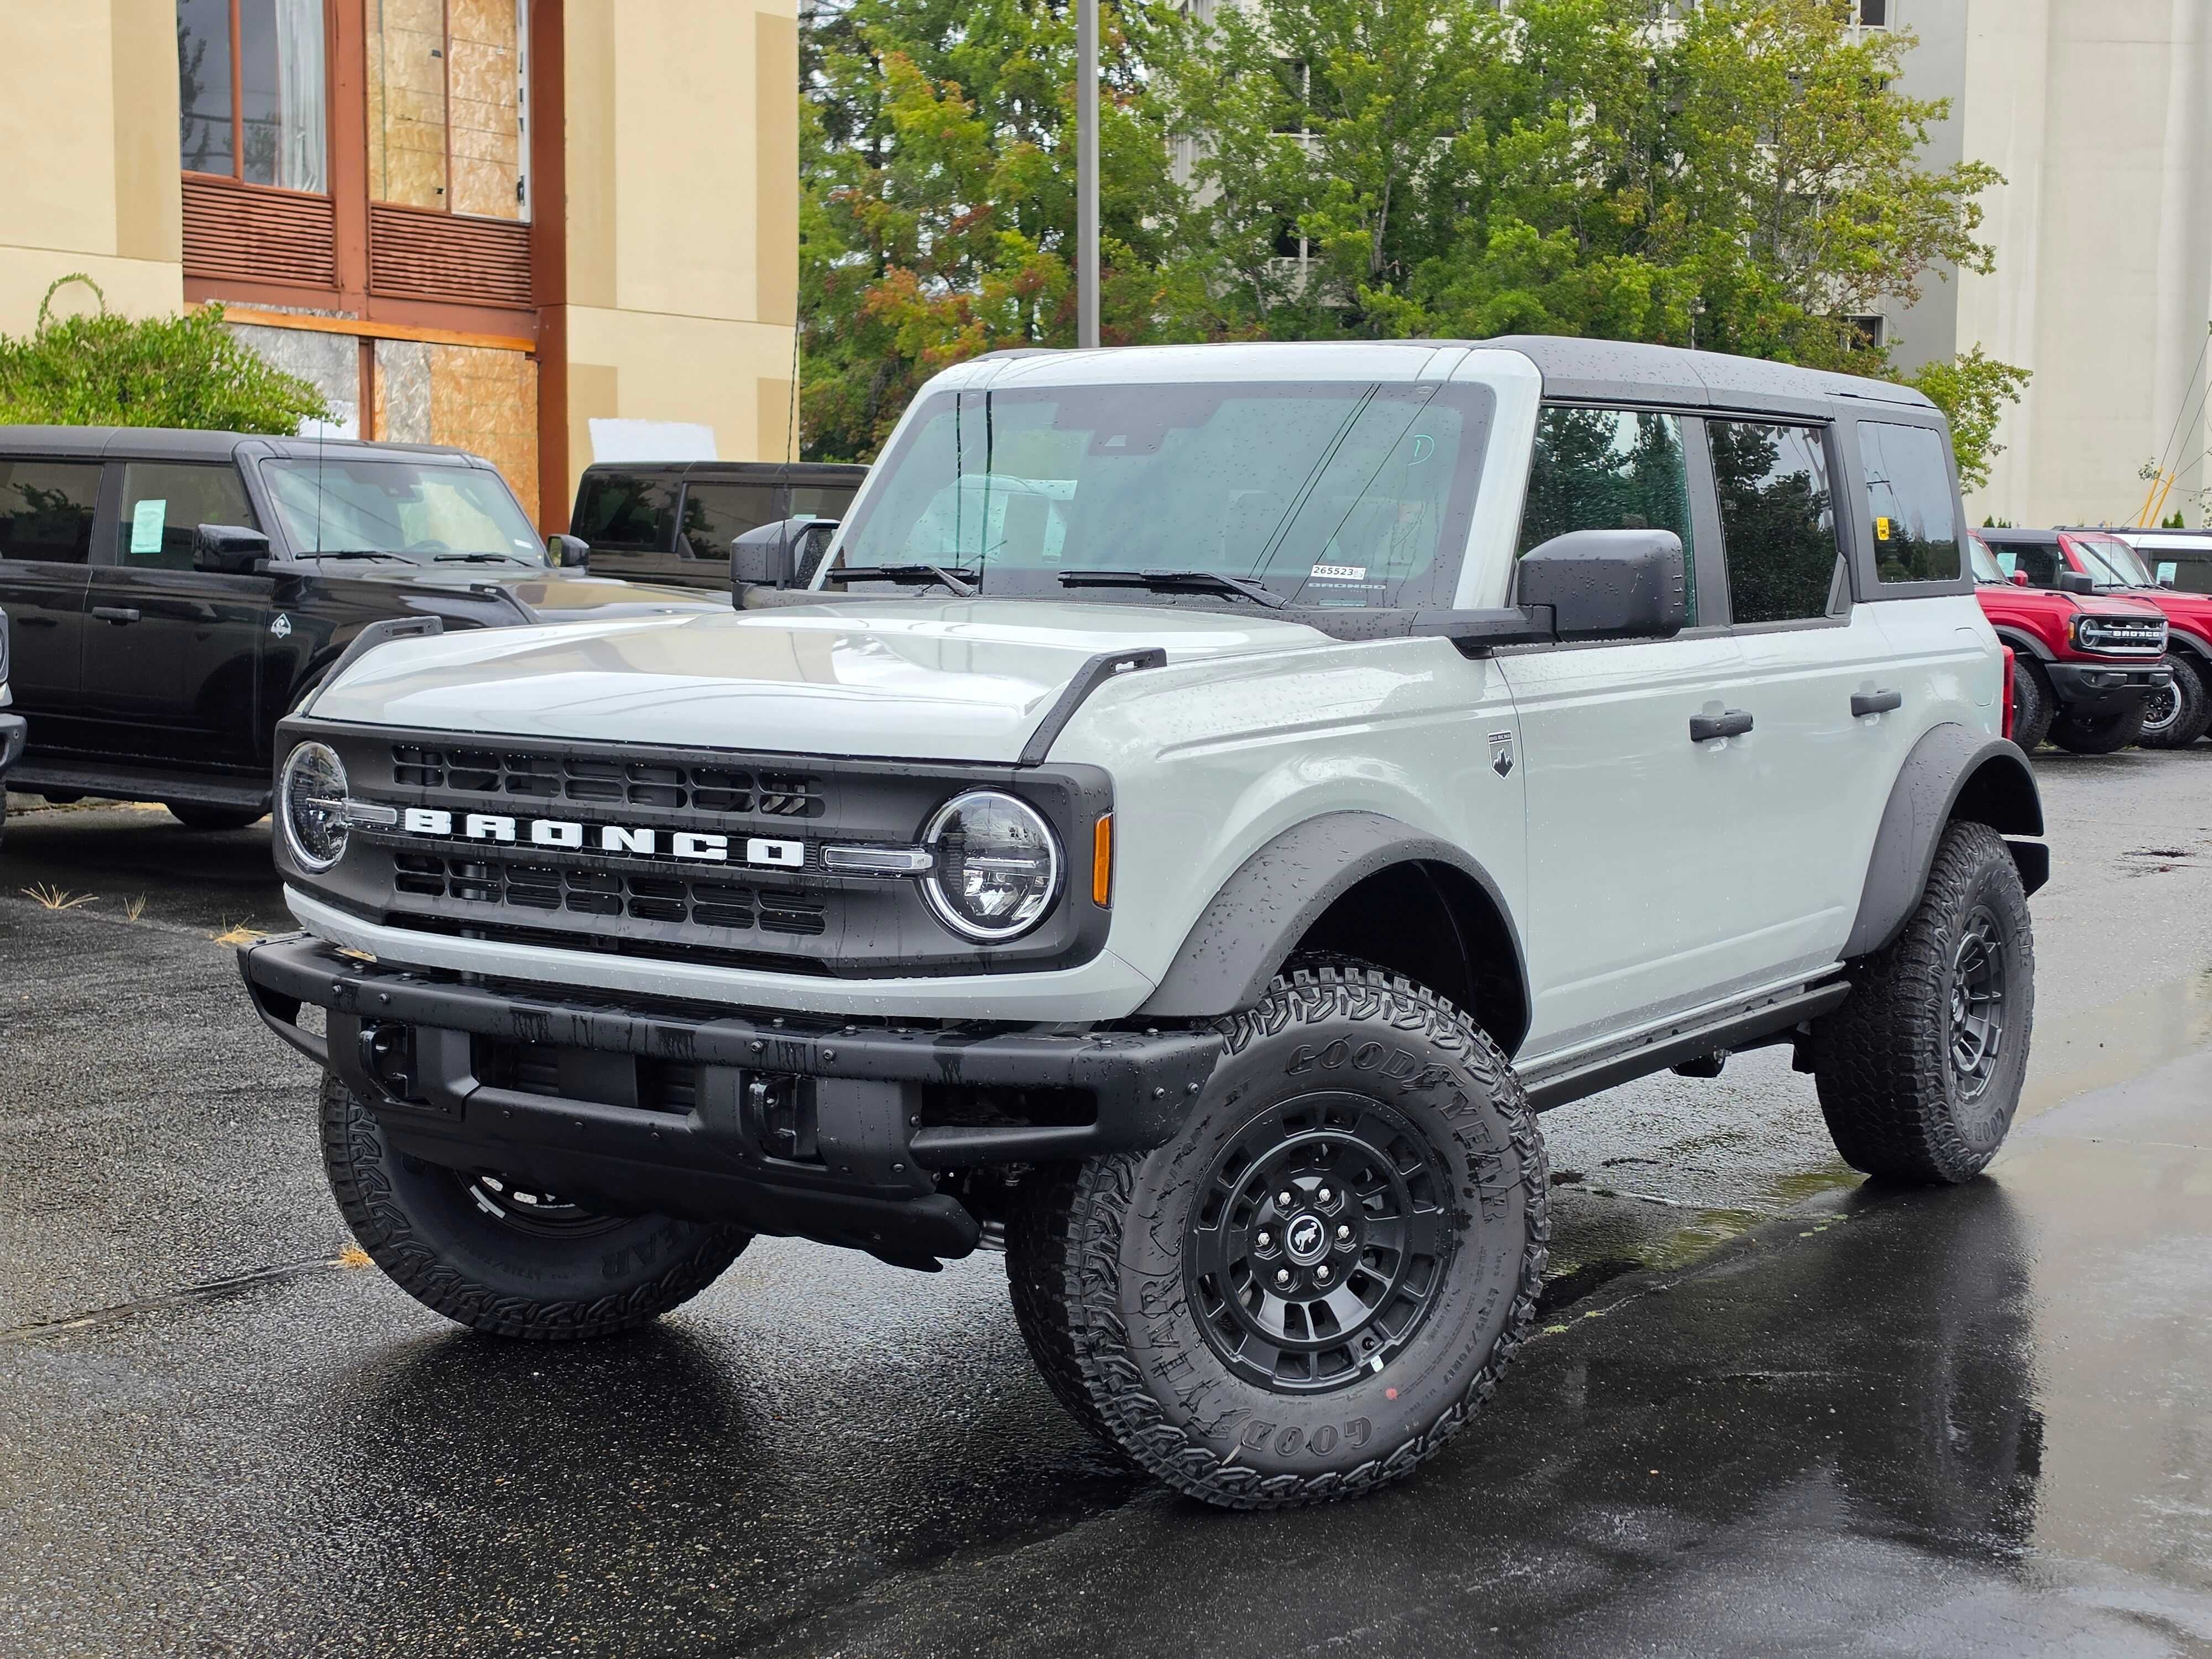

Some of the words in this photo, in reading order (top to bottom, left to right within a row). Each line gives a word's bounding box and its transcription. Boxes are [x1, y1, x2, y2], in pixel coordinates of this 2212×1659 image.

[405, 807, 804, 867] BRONCO
[1286, 1039, 1511, 1219] GOODYEAR
[1140, 1279, 1374, 1457] GOODYEAR
